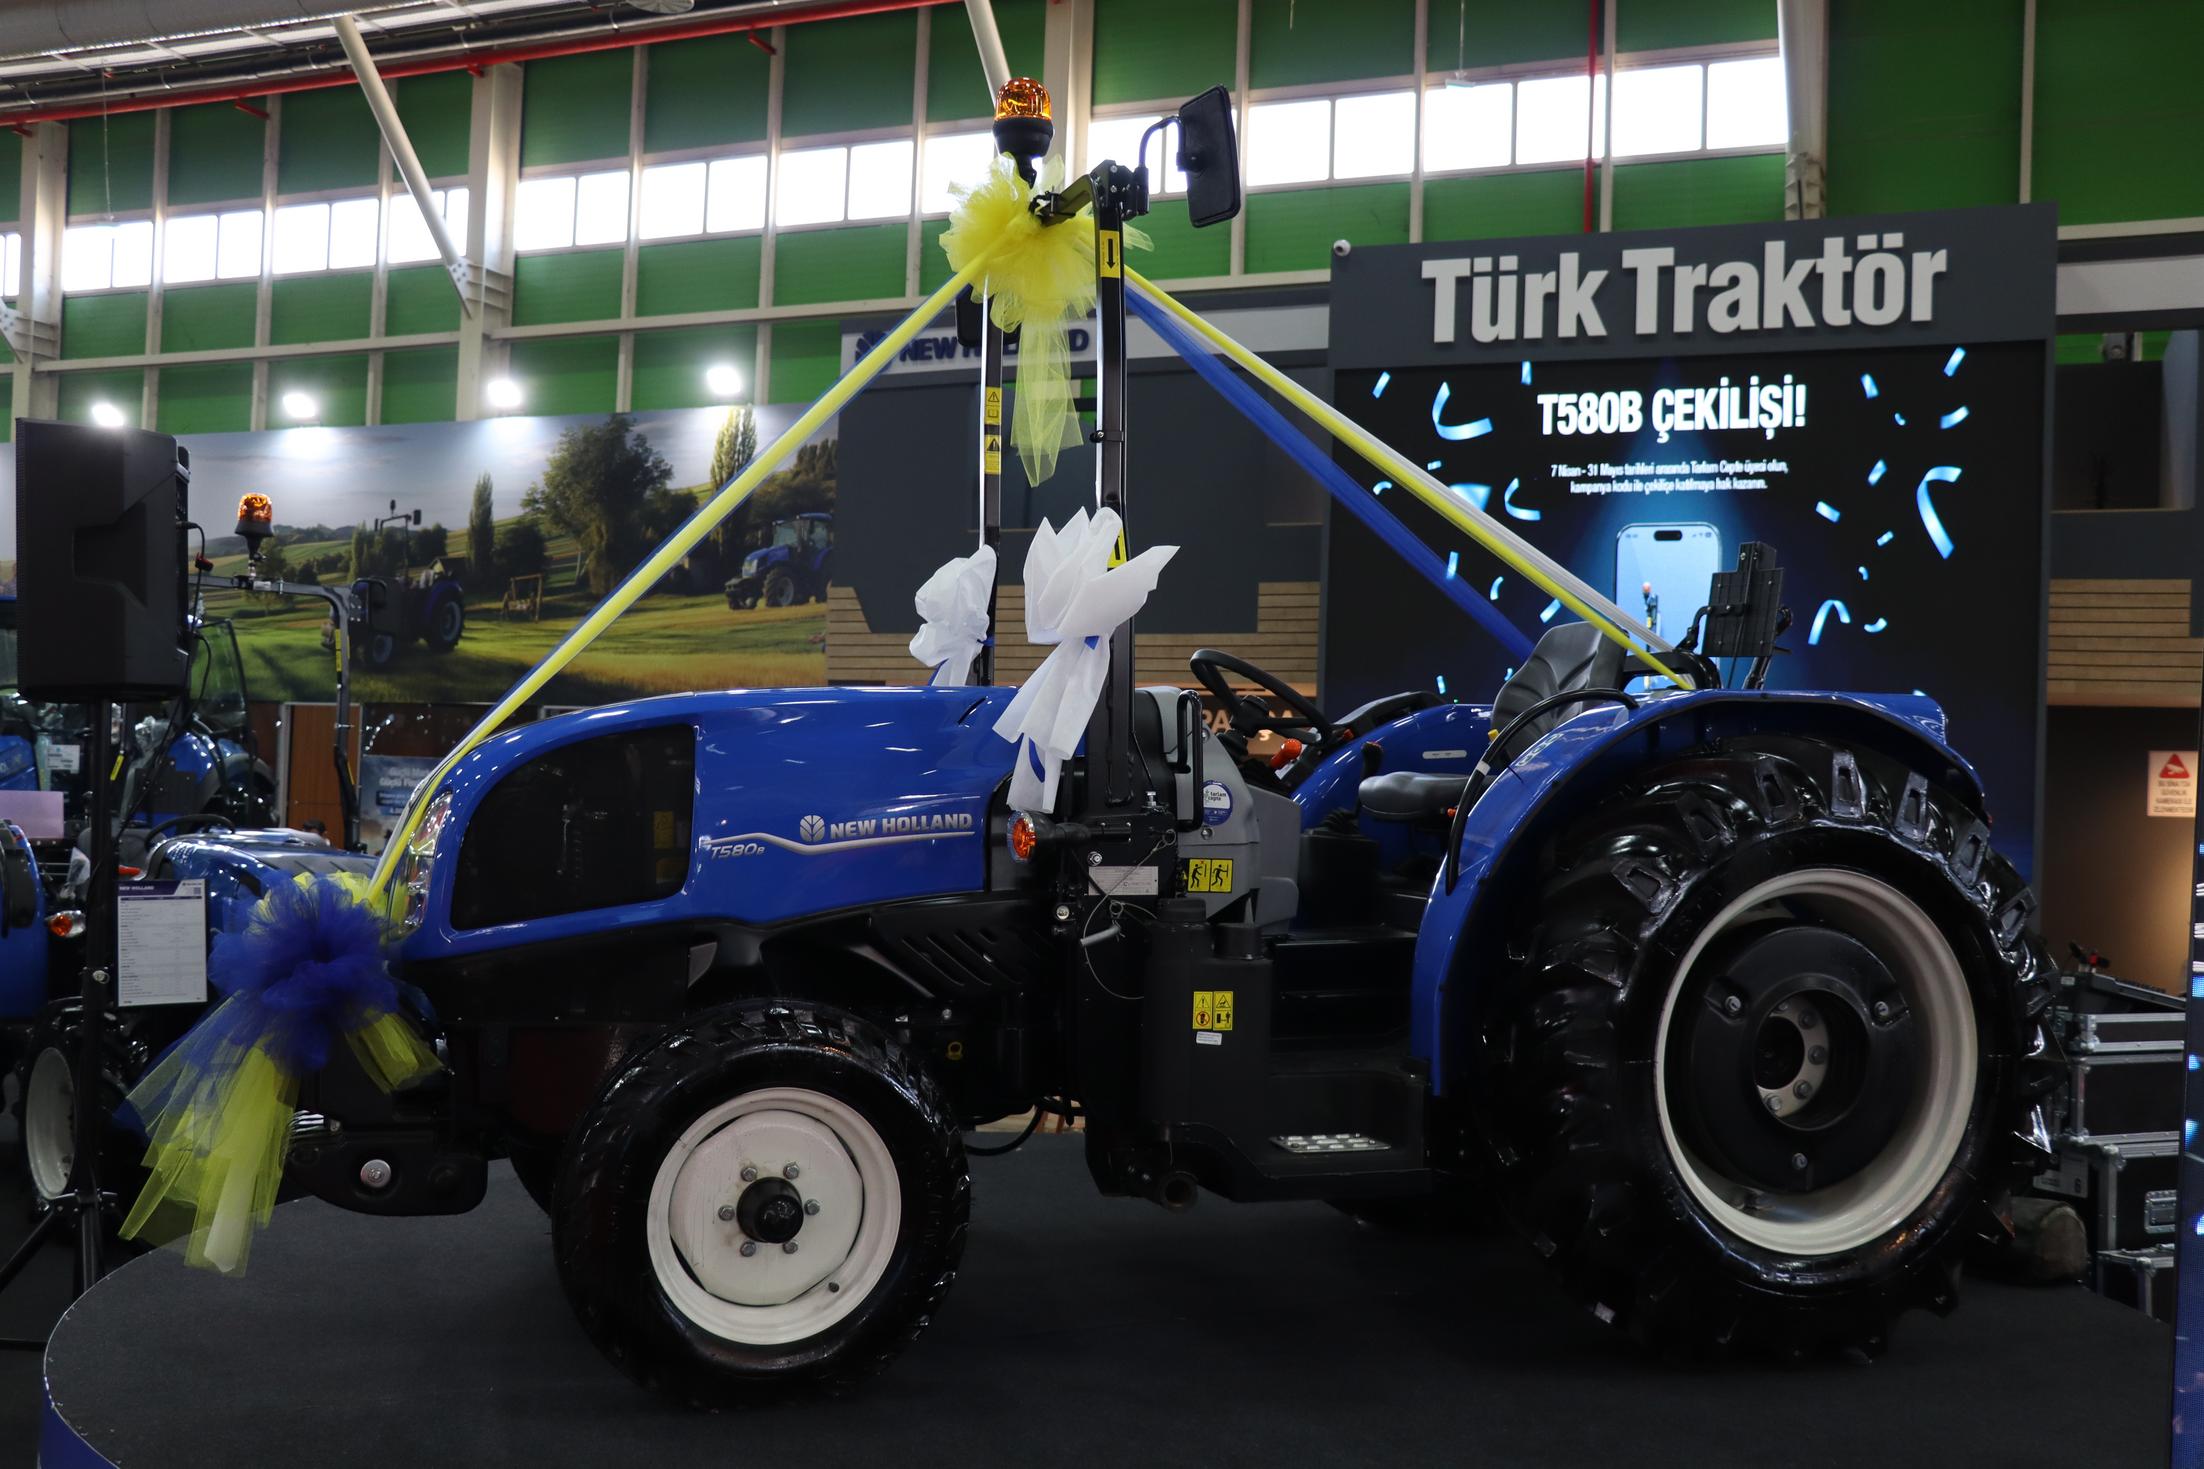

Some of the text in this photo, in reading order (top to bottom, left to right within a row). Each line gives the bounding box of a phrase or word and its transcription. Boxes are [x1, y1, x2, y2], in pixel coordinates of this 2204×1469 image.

[1421, 232, 1947, 343] Türk Traktör
[900, 336, 957, 361] NEW
[1537, 374, 1806, 443] T580B ÇEKİLİŞİ!
[1551, 465, 1557, 477] 7
[1558, 463, 1581, 477] Nisan
[1587, 463, 1598, 476] 31
[1600, 462, 1623, 479] Mayıs
[1570, 479, 1611, 495] kampanya
[1612, 479, 1633, 492] kodu
[1715, 477, 1732, 491] hak
[830, 813, 972, 840] NEW HOLLAND
